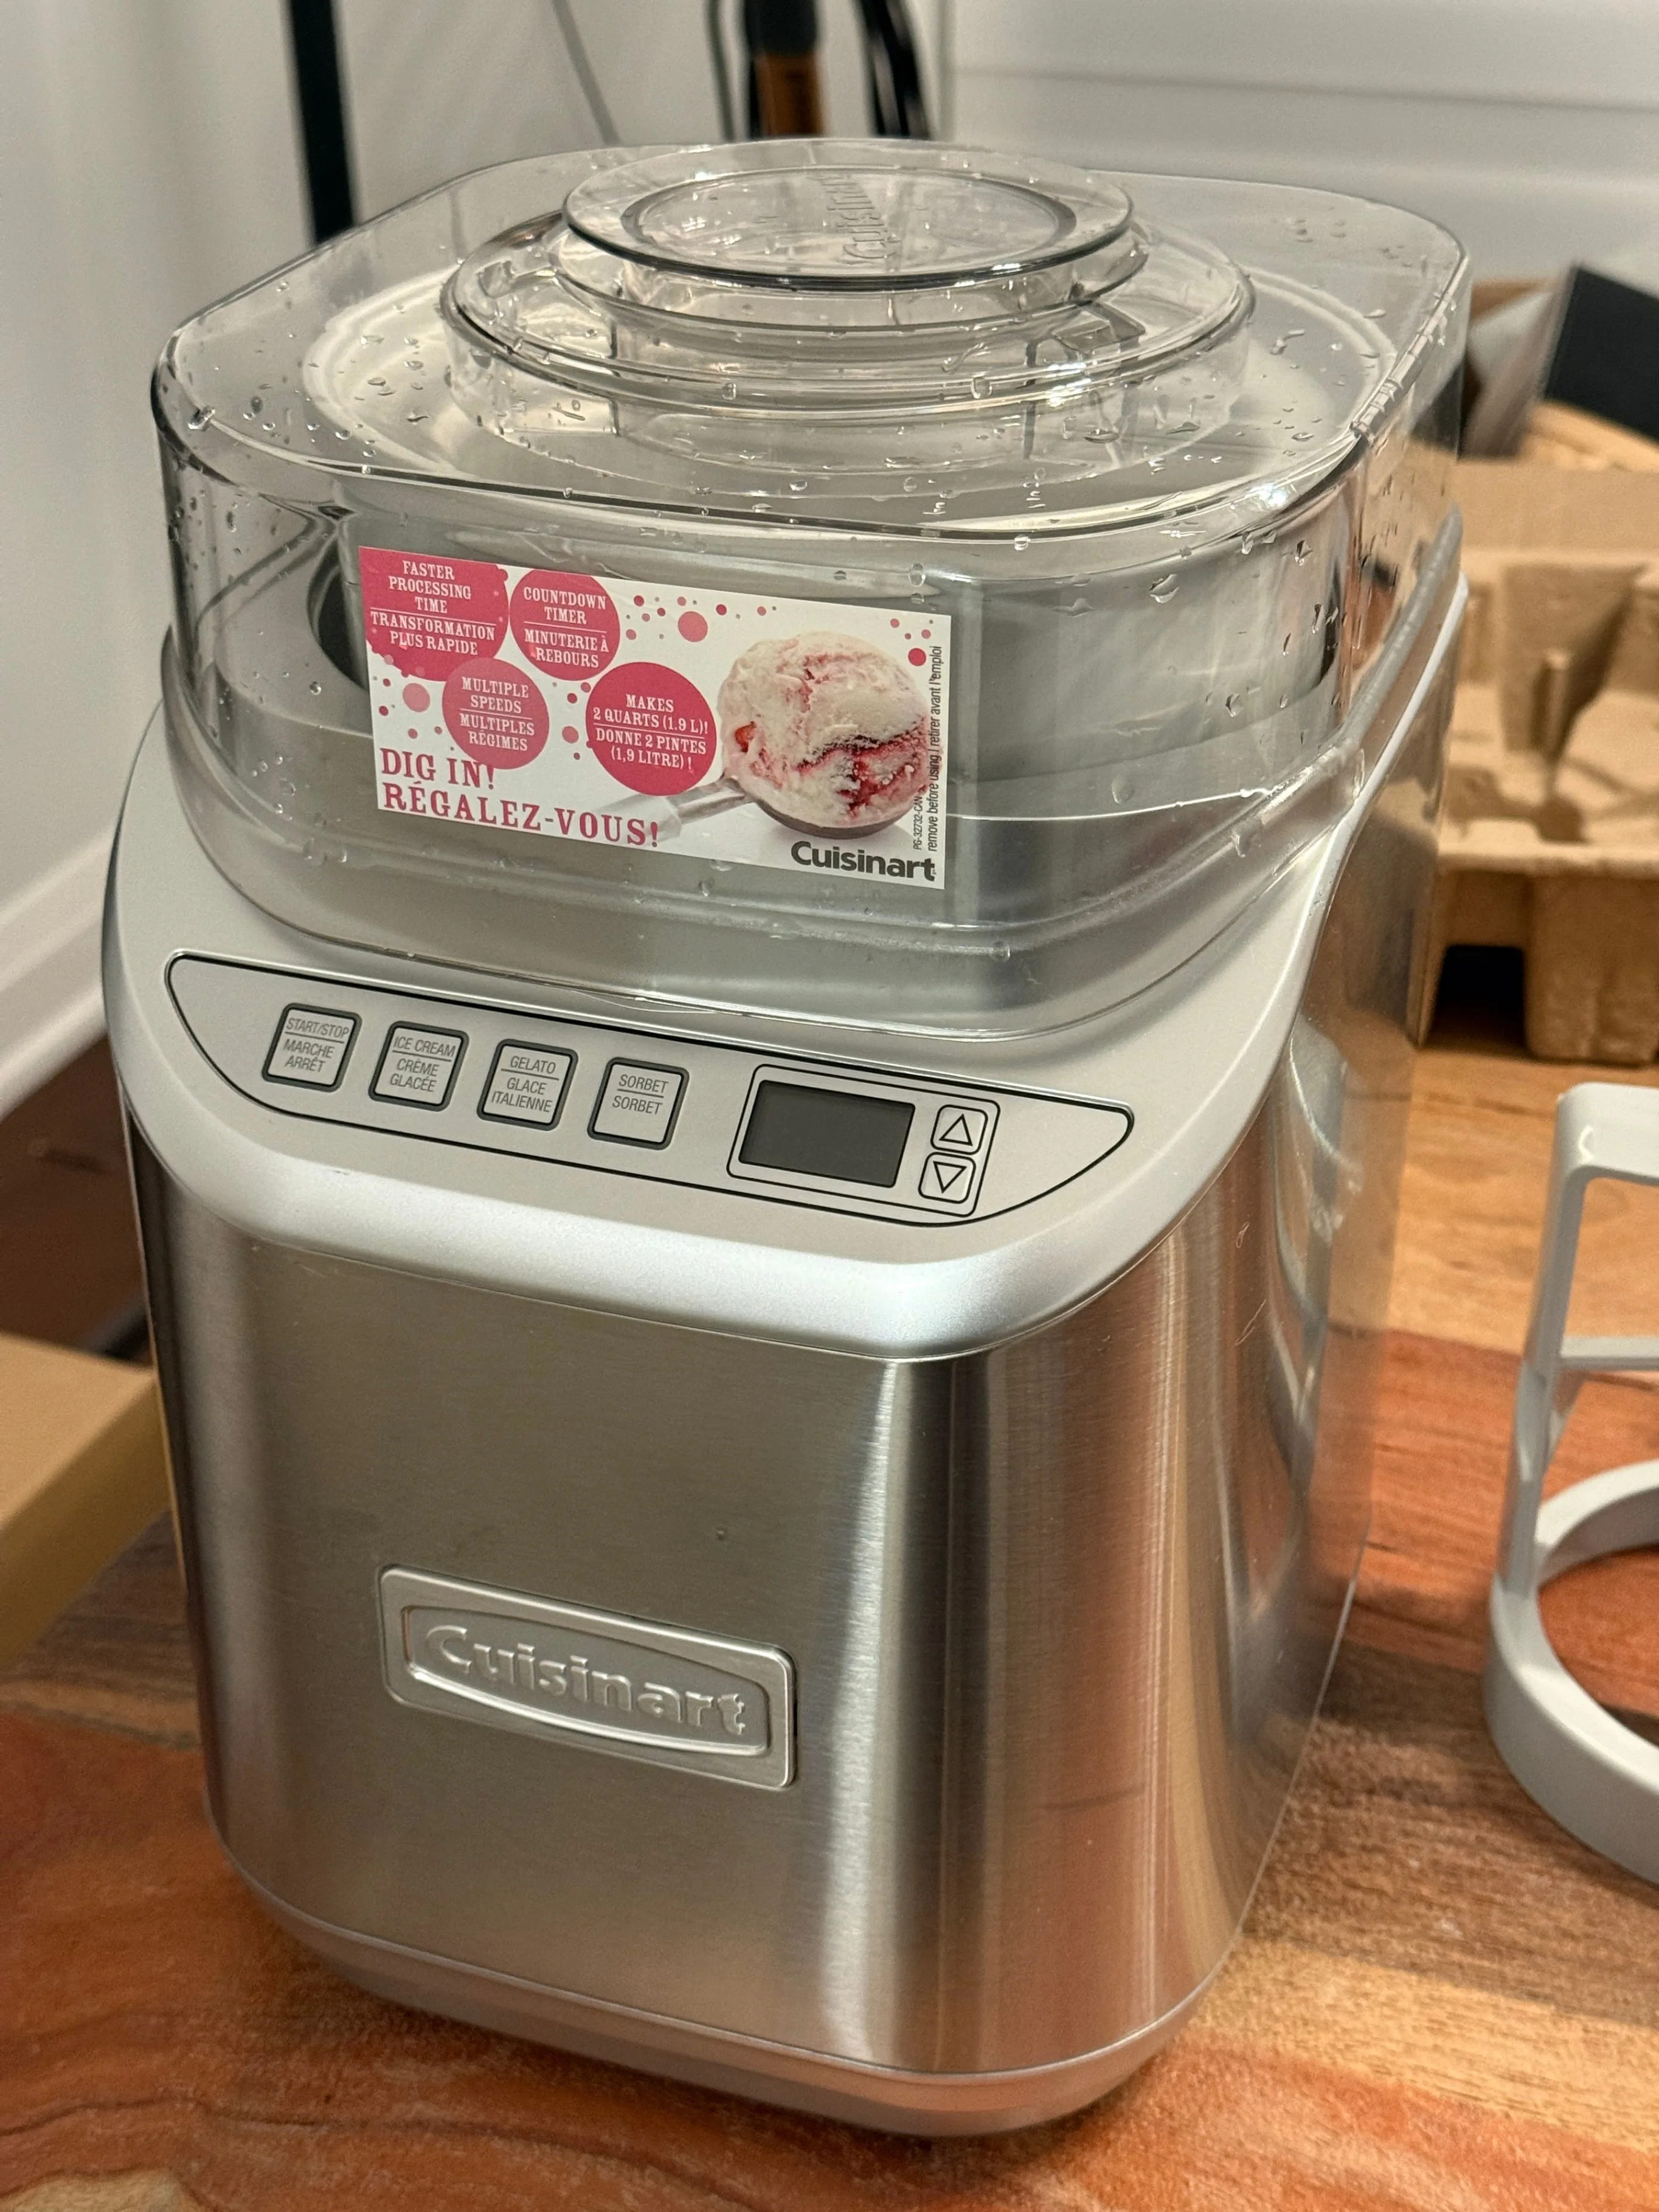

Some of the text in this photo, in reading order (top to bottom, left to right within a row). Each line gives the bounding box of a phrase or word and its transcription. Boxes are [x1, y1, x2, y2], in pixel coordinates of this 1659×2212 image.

[402, 560, 455, 580] FASTER
[388, 576, 471, 600] PROCESSING
[523, 587, 606, 609] COUNTDOWN
[415, 596, 448, 613] TIME
[544, 606, 587, 624] TIMER
[370, 610, 495, 640] TRANSFORMATION
[389, 631, 478, 655] PLUS RAPIDE
[524, 628, 609, 652] MINUTERIE À
[535, 647, 599, 668] REBOURS
[462, 676, 529, 698] MULTIPLE
[471, 695, 522, 714] SPEEDS
[625, 693, 674, 713] MAKES
[929, 688, 940, 715] avant
[459, 713, 535, 736] MULTIPLES
[593, 707, 708, 734] 2 QUARTS (1.9 L)!
[928, 717, 940, 747] retirer
[468, 729, 528, 752] RÉGIMES
[596, 727, 707, 755] DONNE 2 PINTES
[379, 747, 494, 790] DIG IN!
[611, 745, 634, 762] (1,9
[638, 750, 684, 769] LITRE)
[927, 755, 941, 781] using
[927, 784, 938, 814] before
[382, 781, 659, 848] RÉGALEZ-VOUS!
[913, 796, 923, 850] PG-32732-CAN
[927, 816, 938, 851] remove
[791, 840, 935, 882] Cuisinart
[286, 1017, 350, 1039] START/STOP
[283, 1039, 335, 1059] MARCHE
[393, 1035, 456, 1057] ICE CREAM
[285, 1055, 327, 1073] ARRÊT
[510, 1056, 556, 1074] GELATO
[390, 1073, 437, 1093] GLACÉE
[507, 1077, 547, 1095] GLACE
[618, 1074, 669, 1093] SORBET
[490, 1090, 553, 1113] ITALIENNE
[612, 1096, 663, 1115] SORBET
[426, 1625, 746, 1735] Cuisinart
